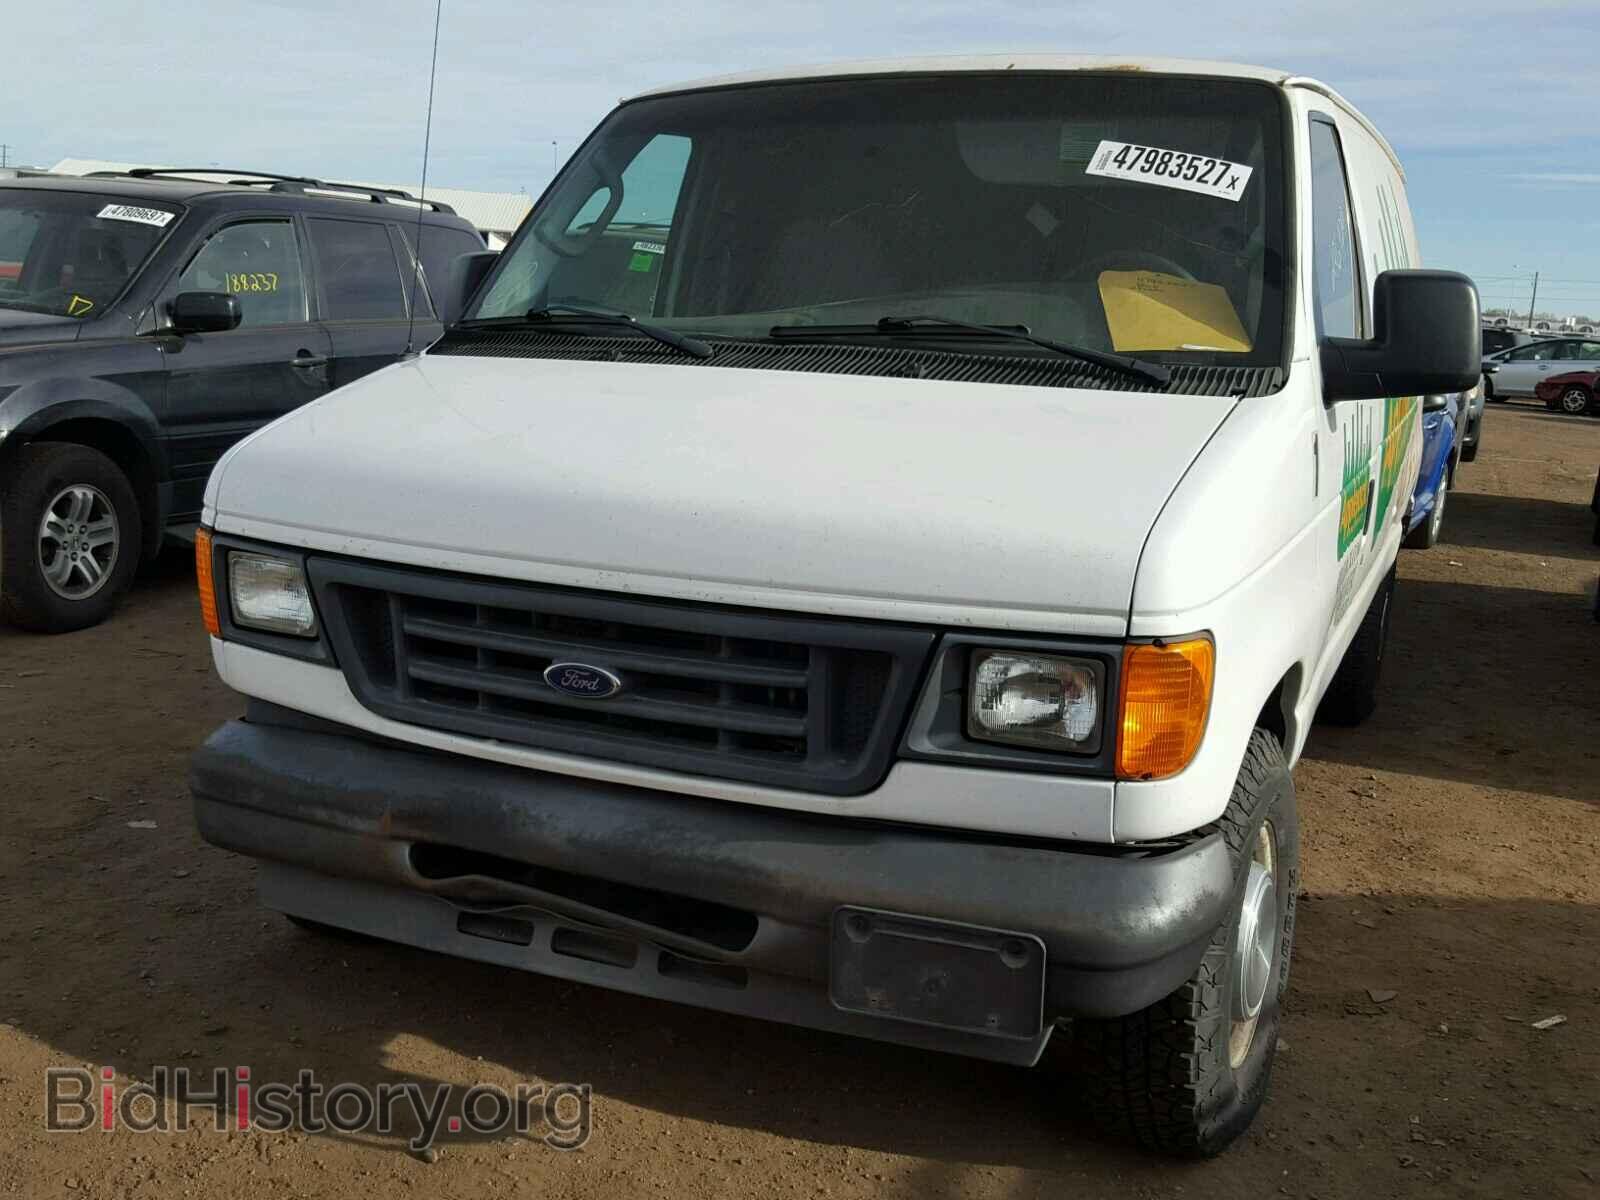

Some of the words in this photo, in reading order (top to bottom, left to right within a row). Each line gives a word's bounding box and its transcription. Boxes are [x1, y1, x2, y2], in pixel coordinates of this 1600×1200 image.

[1112, 144, 1232, 187] 47983527
[225, 272, 279, 293] 188237
[560, 669, 600, 691] Ford
